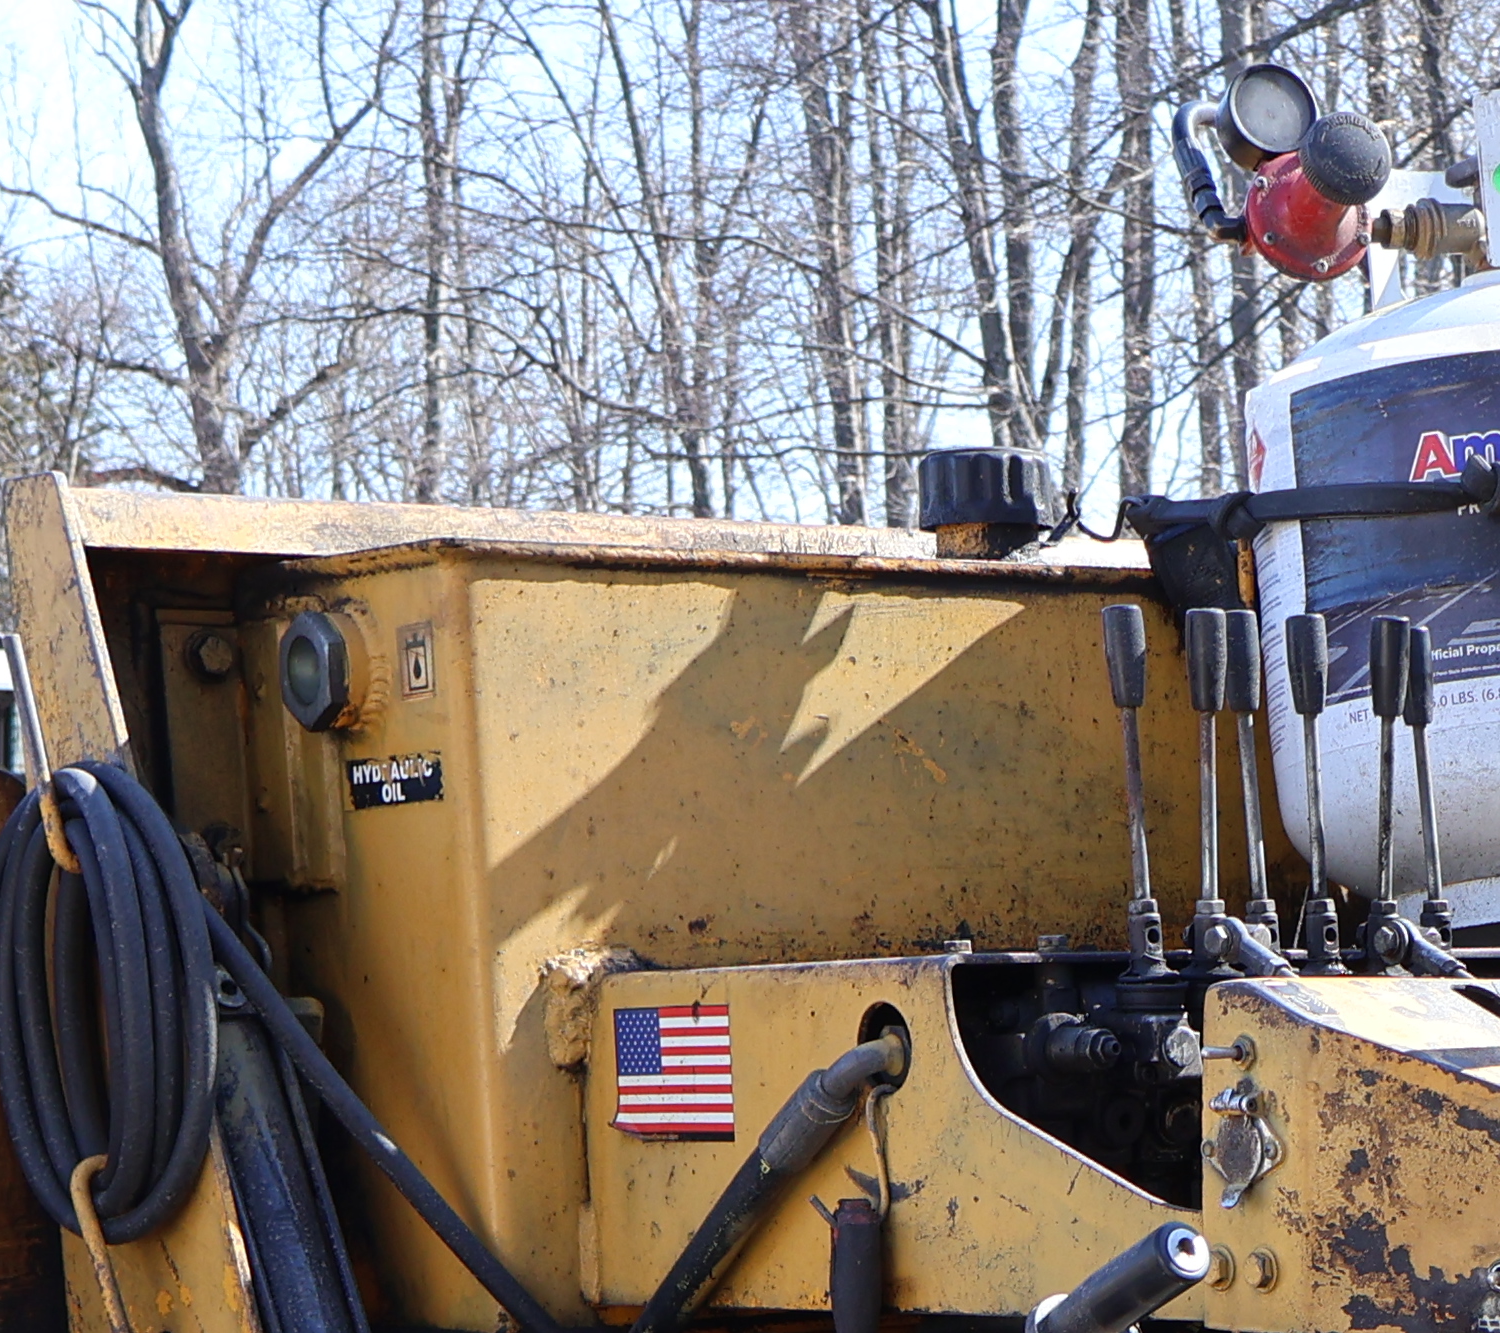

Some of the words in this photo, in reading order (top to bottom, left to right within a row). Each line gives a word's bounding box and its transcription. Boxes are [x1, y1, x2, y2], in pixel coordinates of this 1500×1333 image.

[1431, 646, 1463, 661] fficial
[1349, 708, 1369, 724] NET
[1450, 690, 1478, 706] LBS.
[352, 759, 433, 785] HYDAULC
[381, 782, 406, 803] OIL
